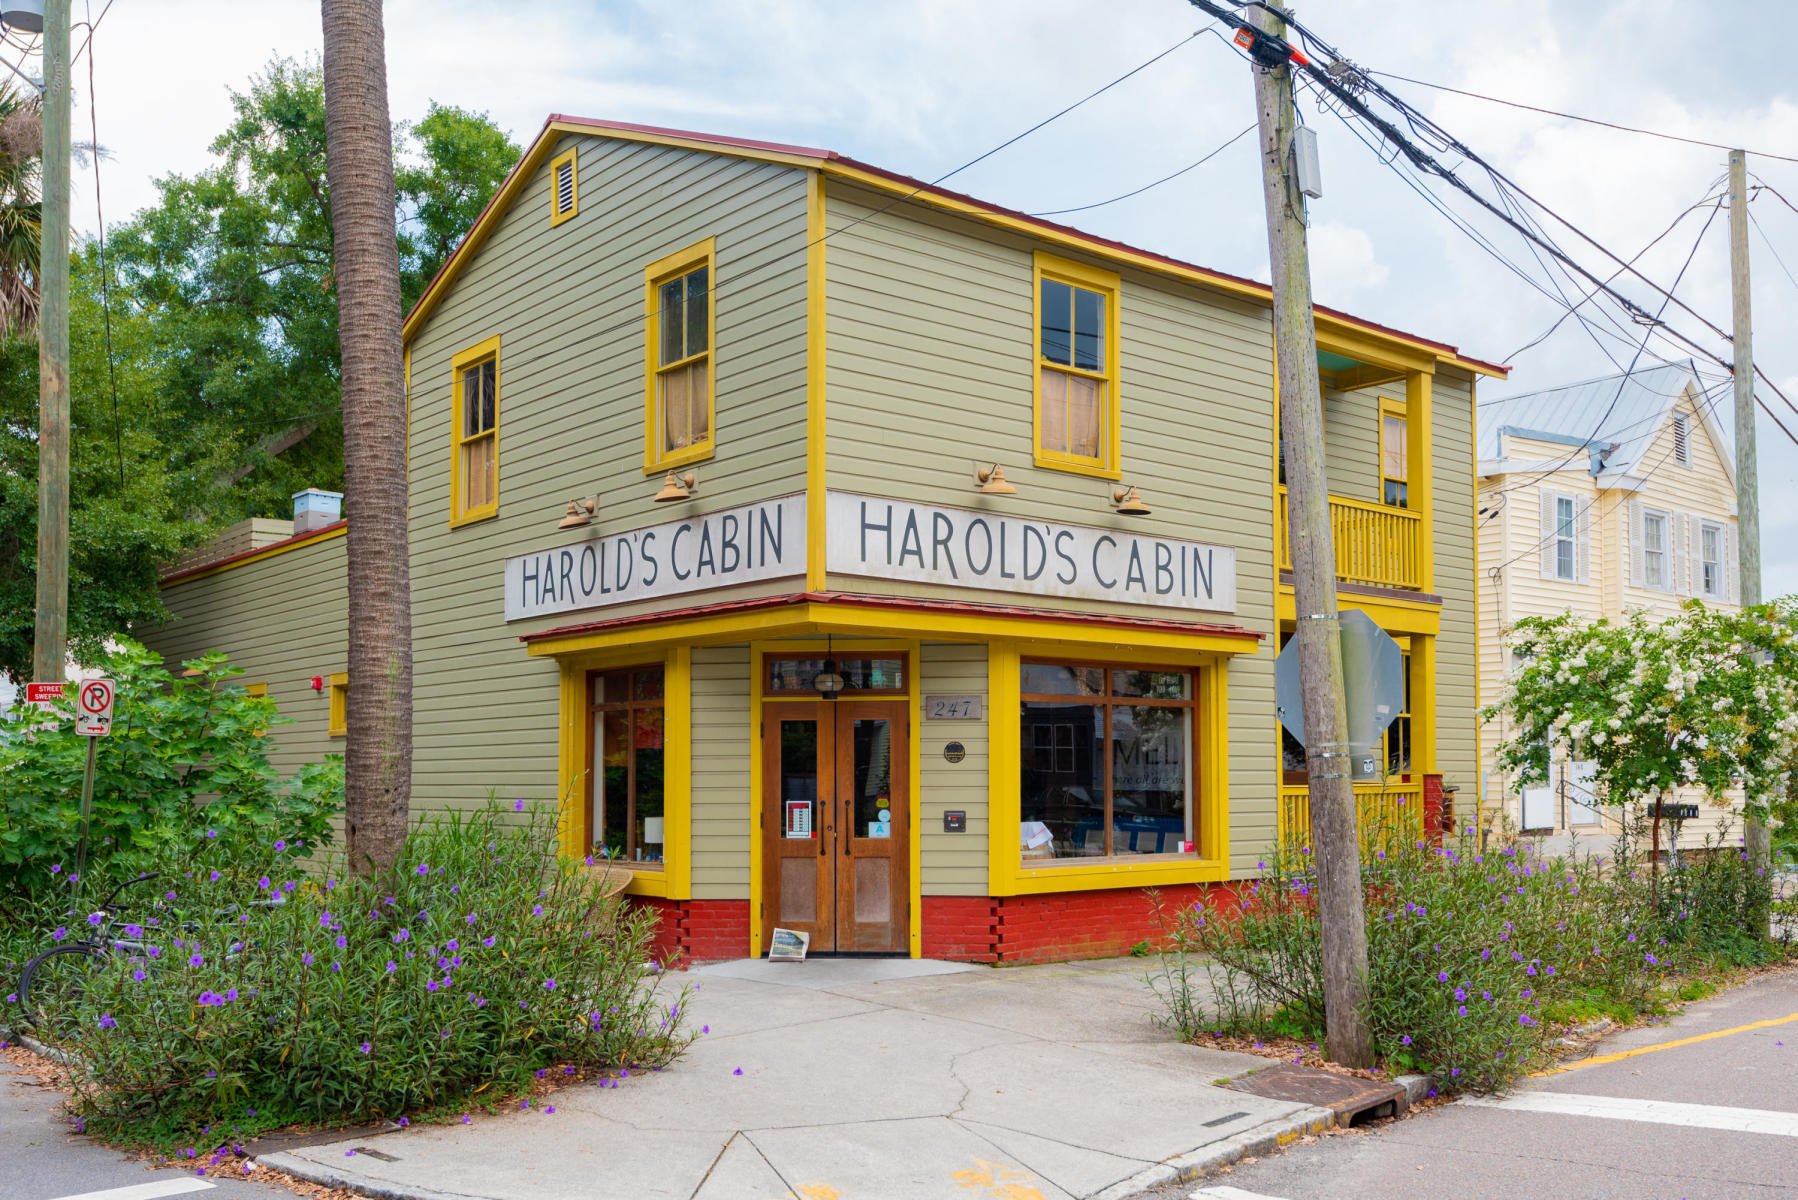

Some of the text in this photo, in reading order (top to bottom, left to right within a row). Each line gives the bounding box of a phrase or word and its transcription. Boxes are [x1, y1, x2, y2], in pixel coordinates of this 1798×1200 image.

[522, 503, 783, 608] HAROLD'S CABIN
[860, 501, 1213, 600] HAROLD'S CABIN
[934, 700, 972, 717] 247
